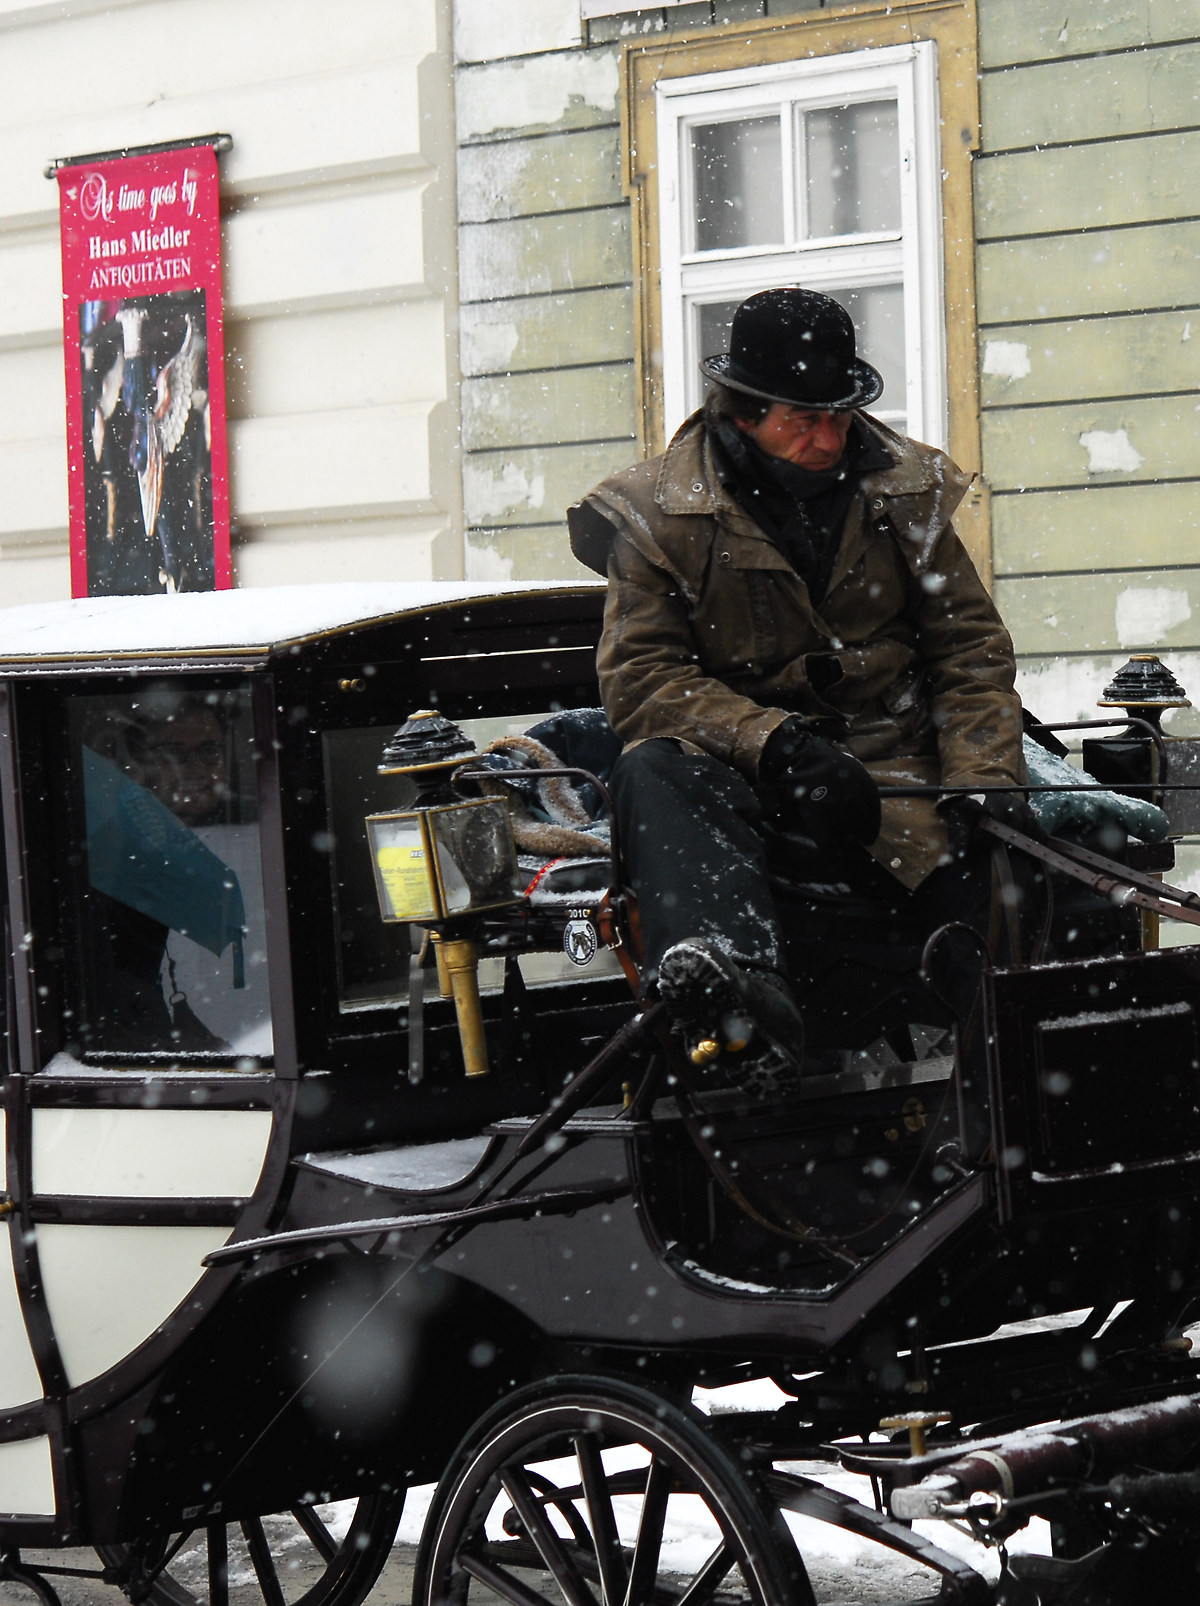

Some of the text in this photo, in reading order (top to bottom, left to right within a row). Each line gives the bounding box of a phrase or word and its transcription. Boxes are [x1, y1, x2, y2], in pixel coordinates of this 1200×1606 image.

[80, 168, 197, 223] As time goes by
[89, 226, 191, 259] Hans Miedler
[90, 257, 191, 289] ANTIQUITÄTEN
